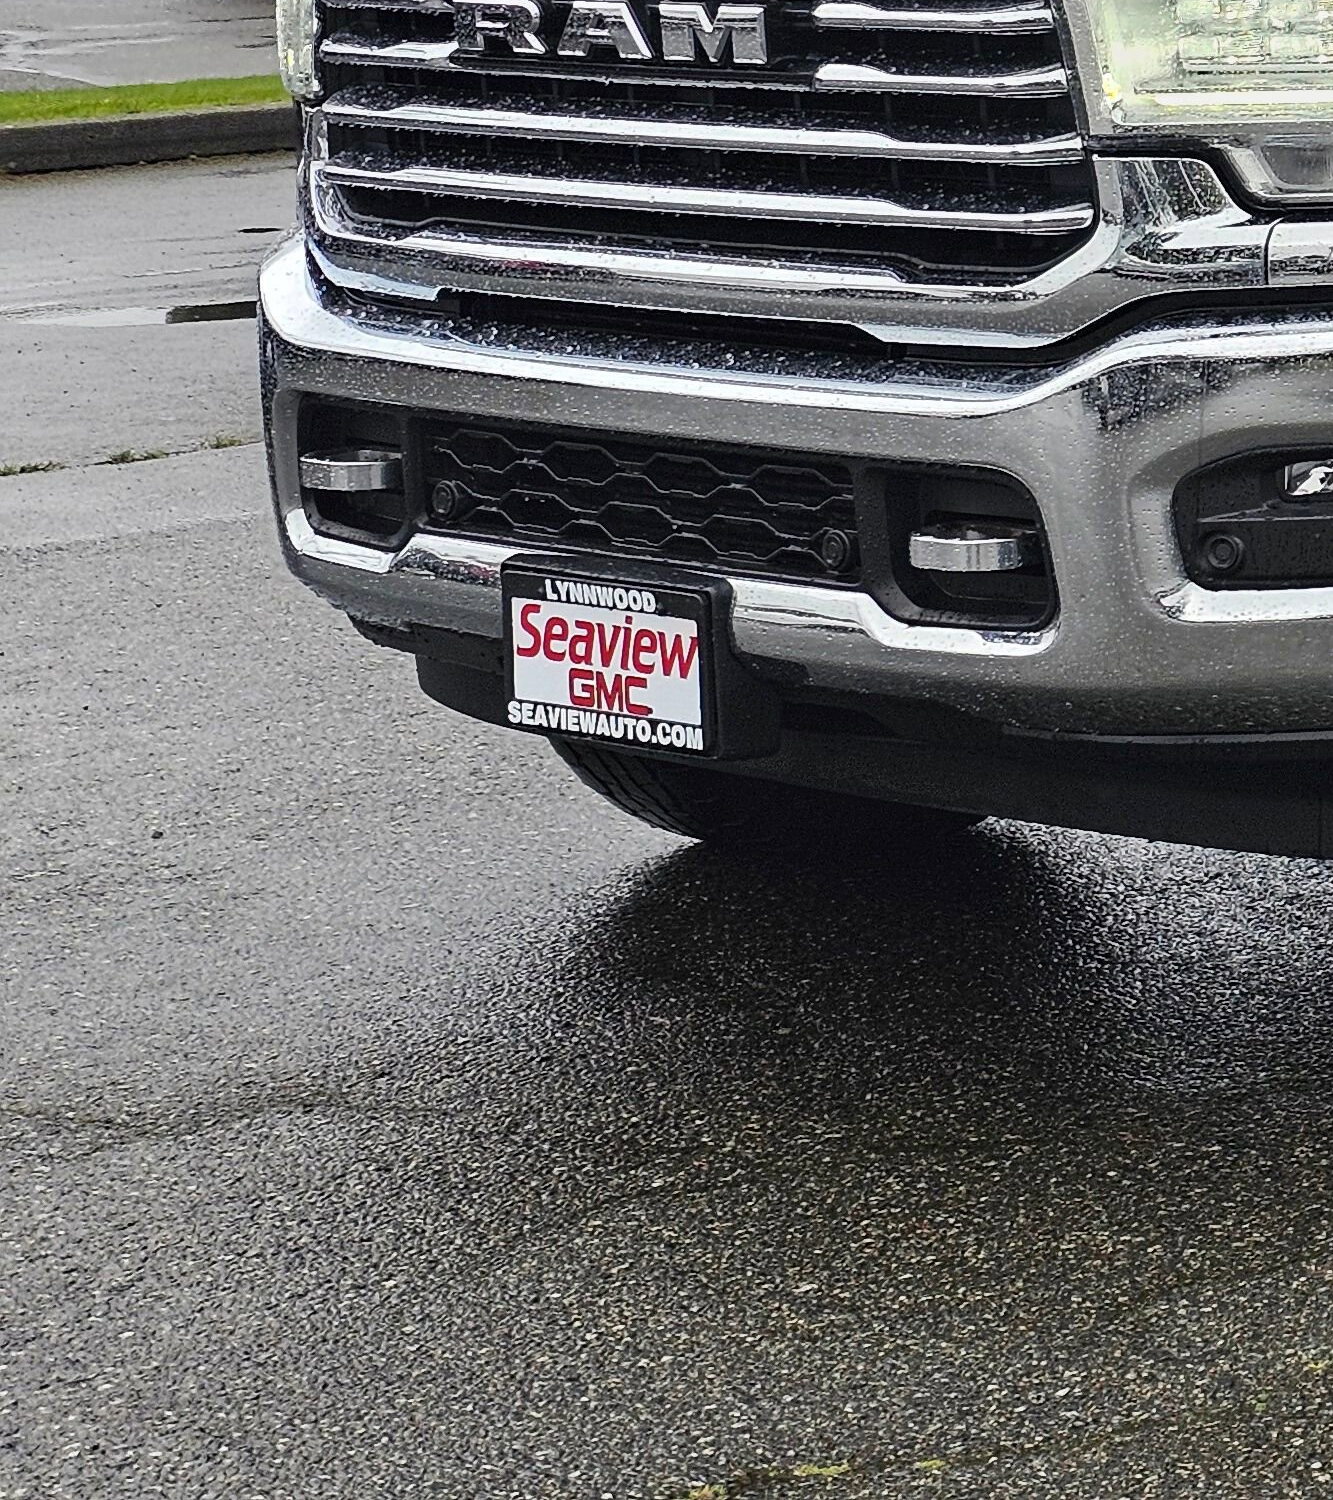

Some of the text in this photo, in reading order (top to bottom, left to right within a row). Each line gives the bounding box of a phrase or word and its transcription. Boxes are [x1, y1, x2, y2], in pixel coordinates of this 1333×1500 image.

[545, 579, 656, 613] LYNNWOOD
[516, 603, 699, 679] Seaview
[568, 668, 653, 716] GMC
[507, 700, 703, 750] SEAVIEWAUTO.COM
